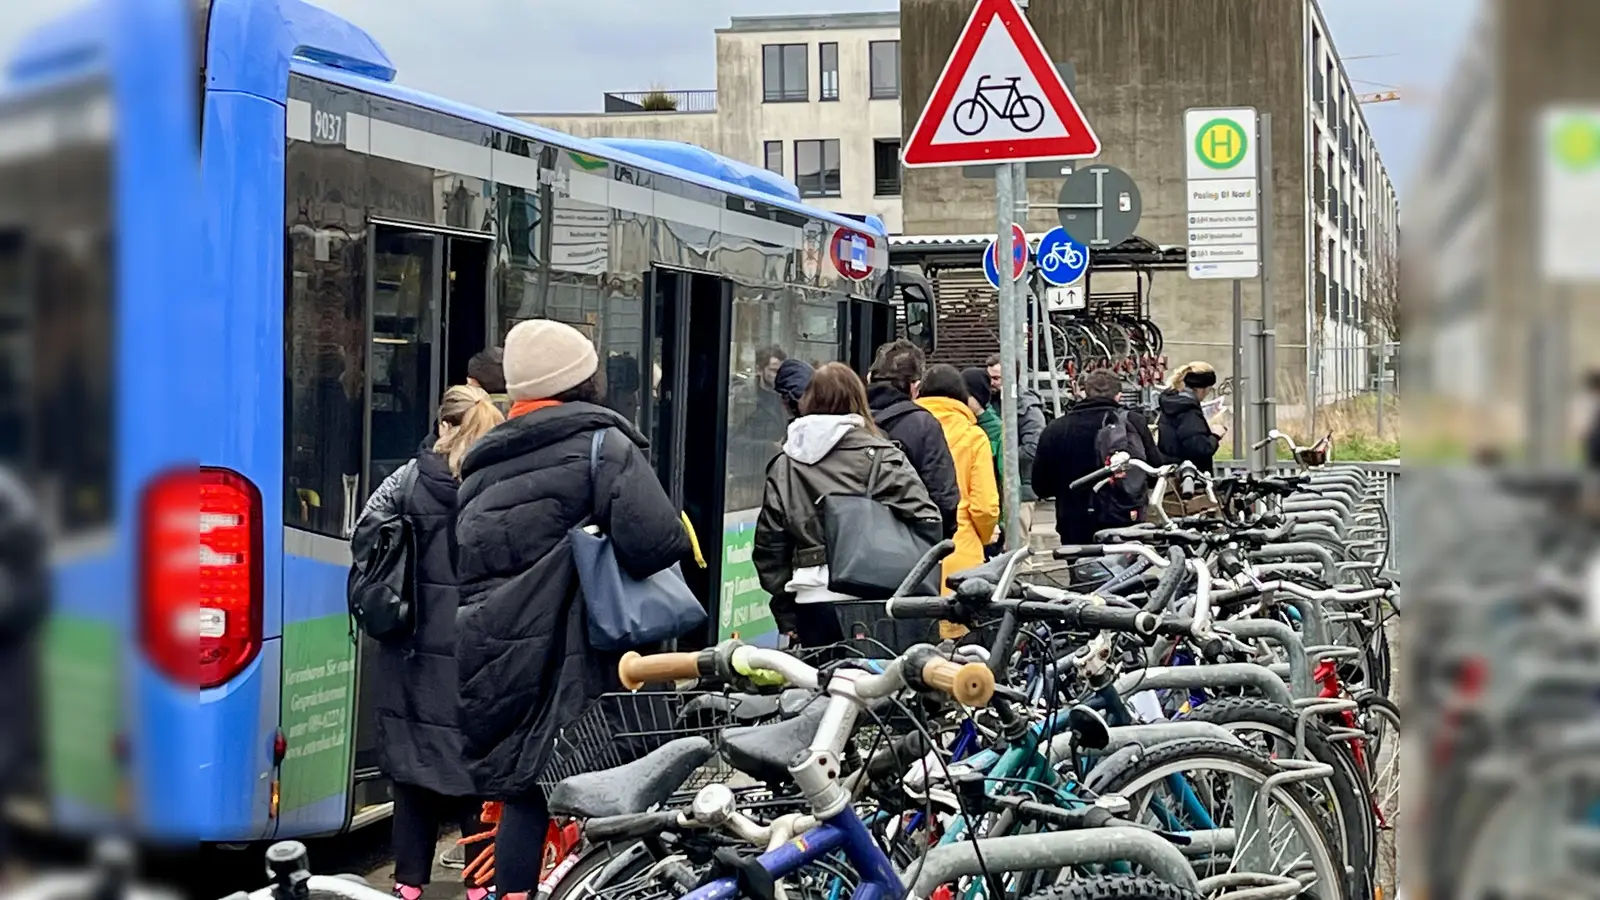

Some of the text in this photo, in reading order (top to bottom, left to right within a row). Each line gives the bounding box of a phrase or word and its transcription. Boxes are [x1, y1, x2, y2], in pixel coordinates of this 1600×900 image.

[315, 110, 341, 141] 9037
[1210, 129, 1231, 158] H
[1193, 191, 1219, 201] Pasing
[1231, 189, 1251, 198] Nord
